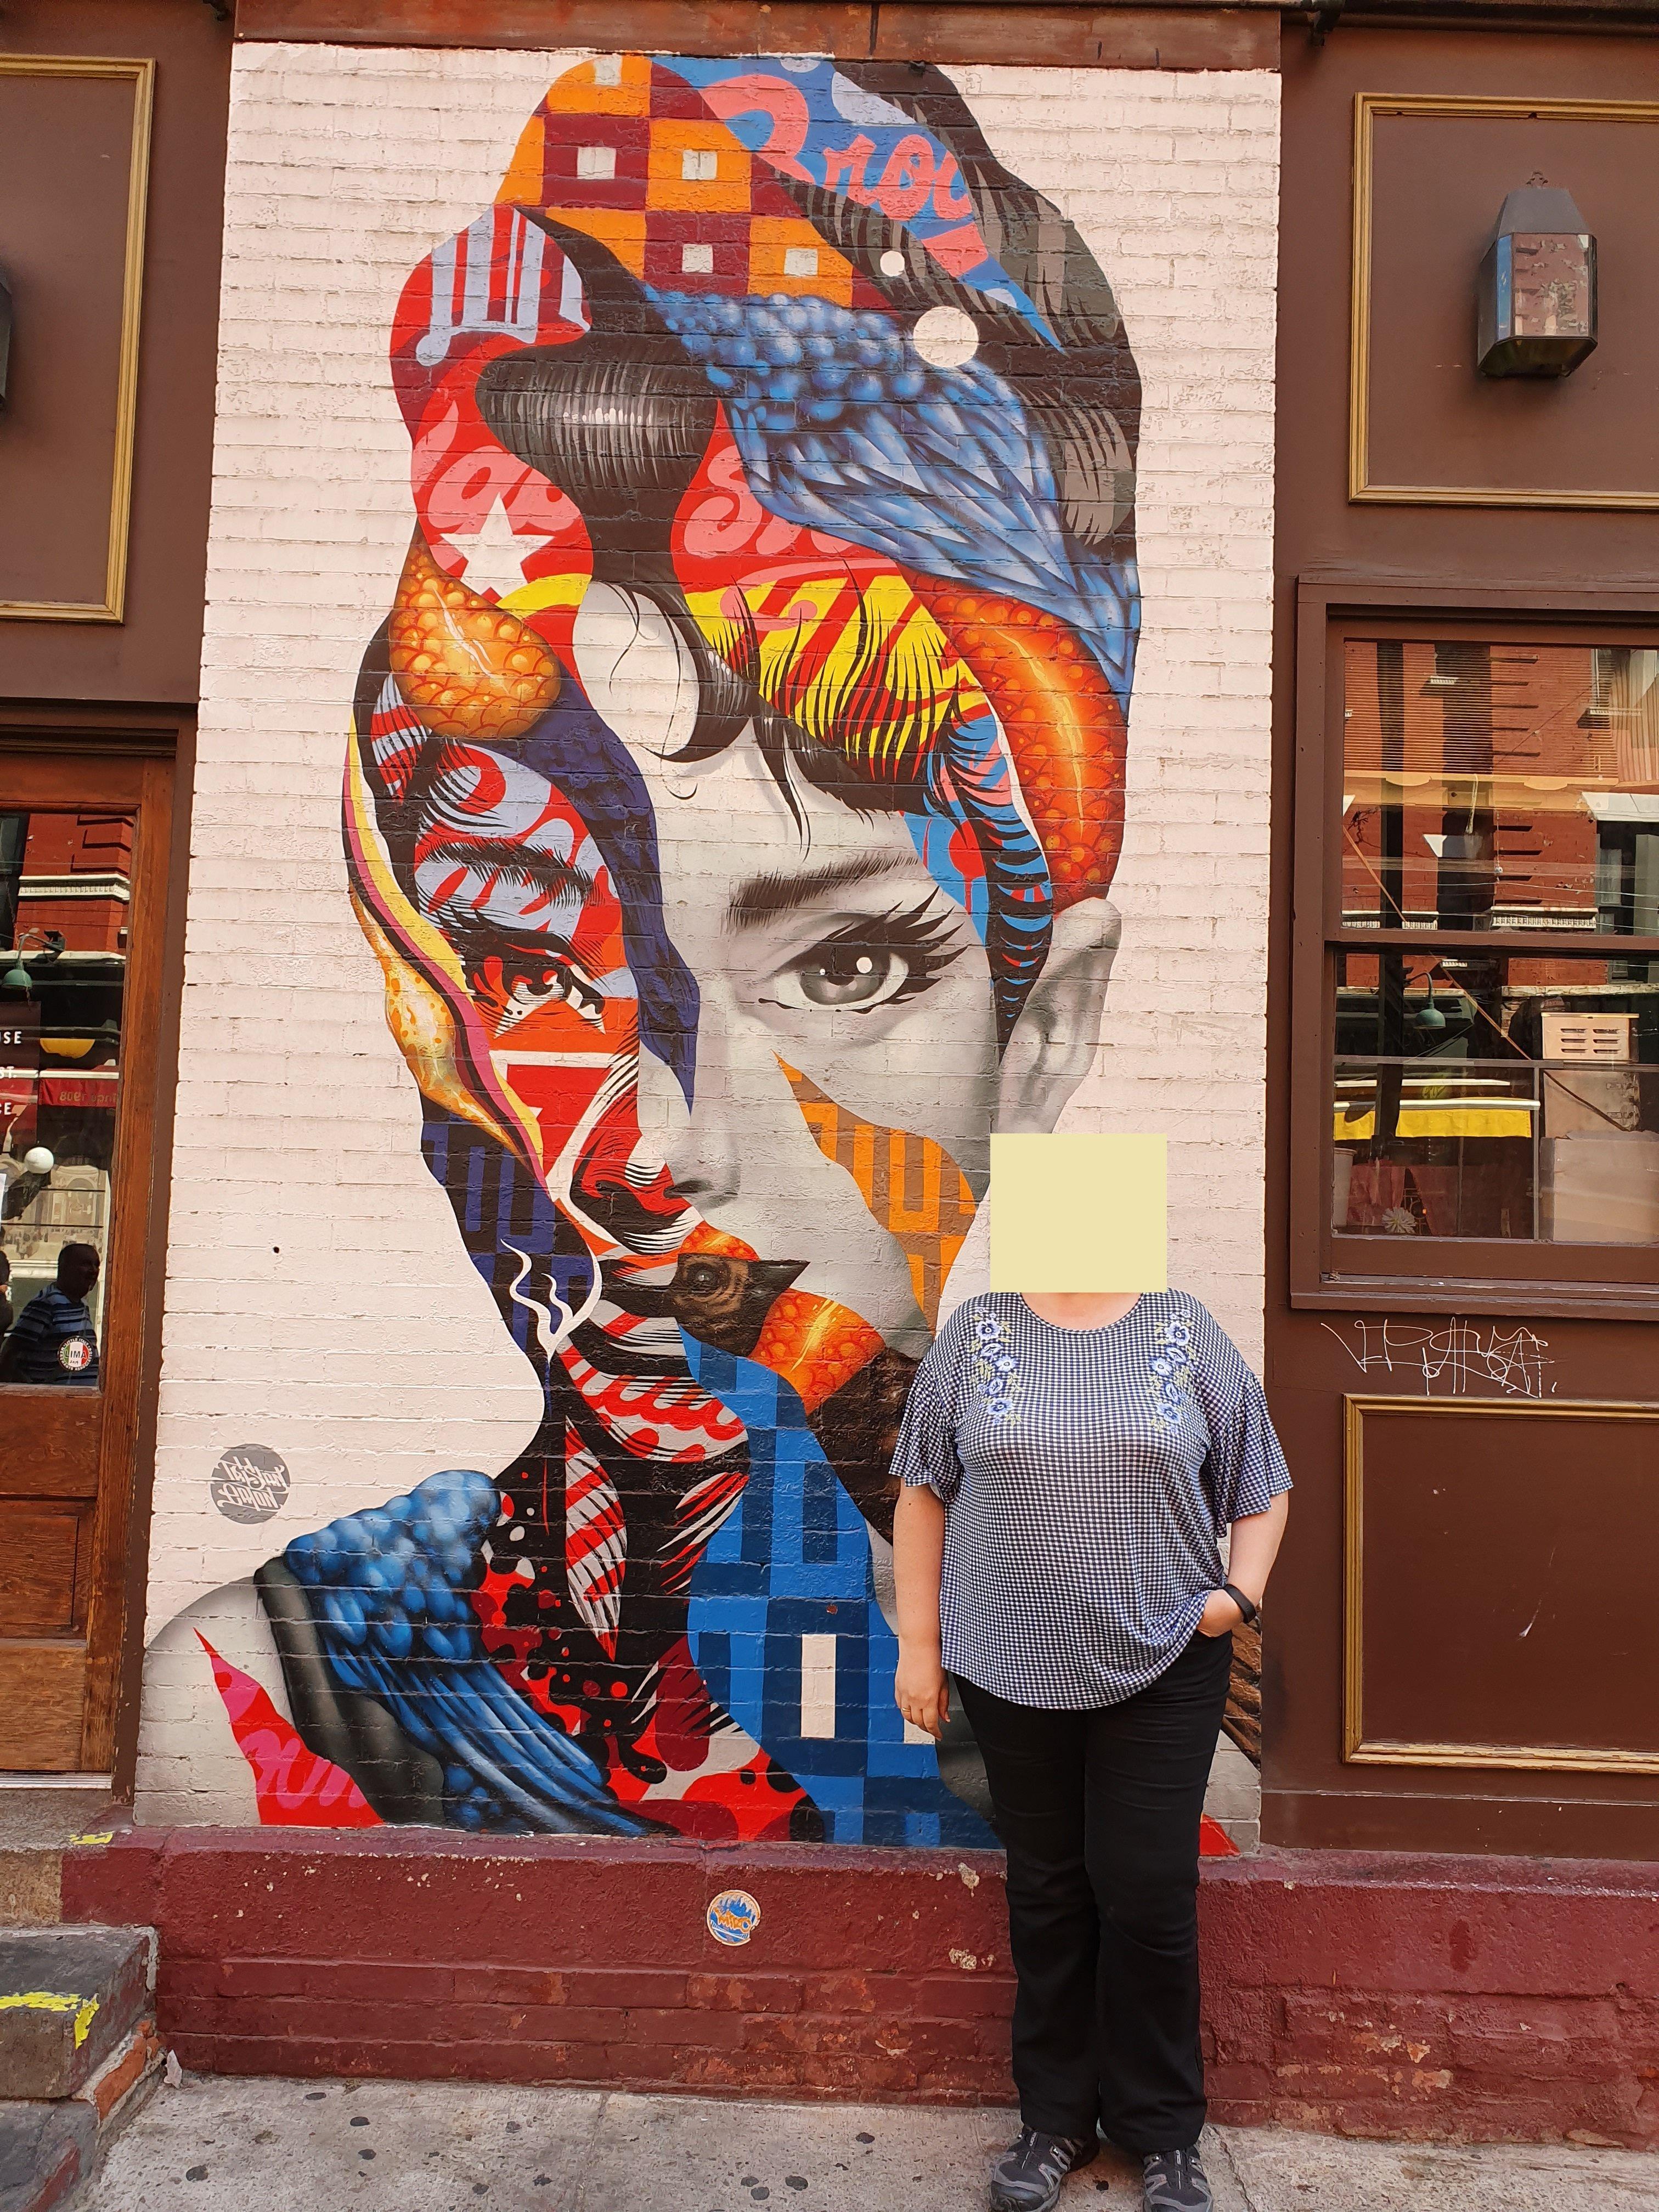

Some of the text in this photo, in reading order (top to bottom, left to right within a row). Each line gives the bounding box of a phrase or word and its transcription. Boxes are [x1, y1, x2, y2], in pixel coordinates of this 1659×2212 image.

[0, 1031, 22, 1044] SE
[0, 1102, 12, 1115] E
[65, 1350, 87, 1359] LIMA
